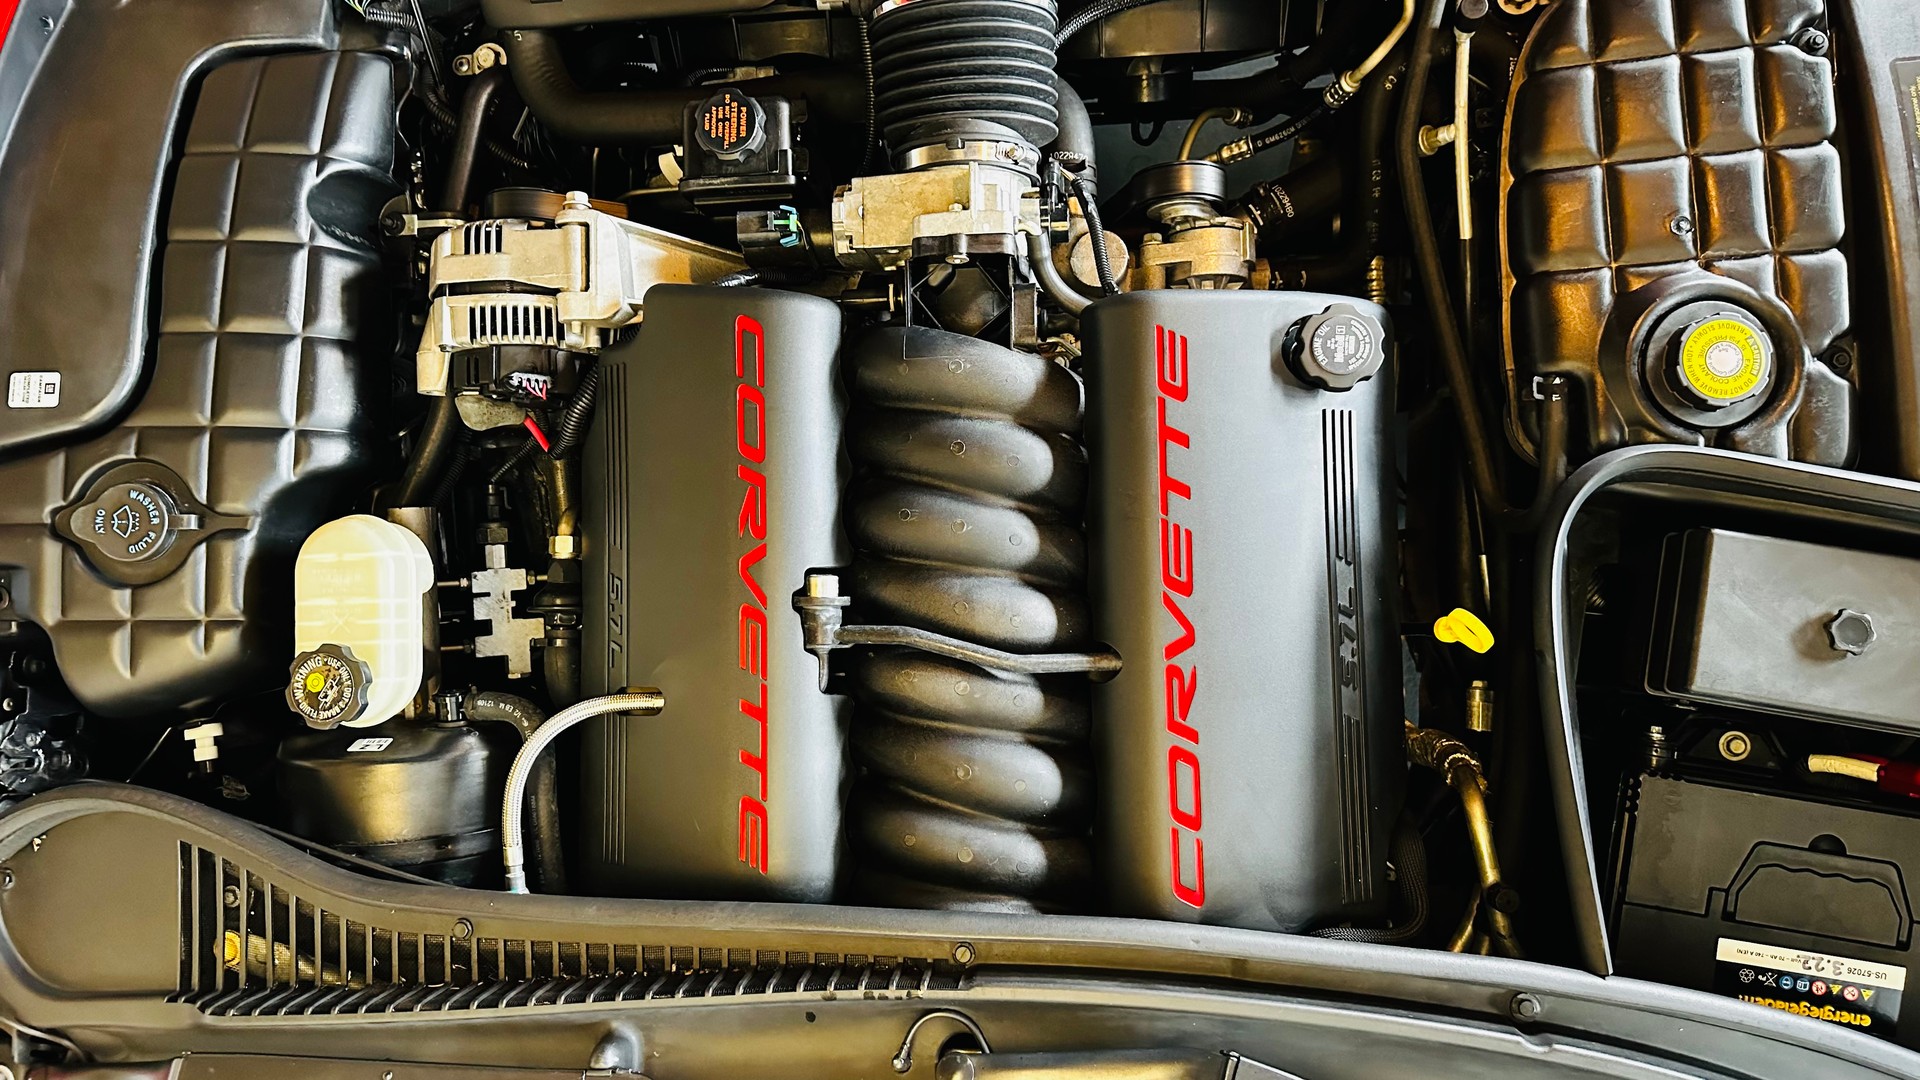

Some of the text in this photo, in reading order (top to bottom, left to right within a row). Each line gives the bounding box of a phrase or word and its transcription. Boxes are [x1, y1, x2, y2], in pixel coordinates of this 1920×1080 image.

[725, 94, 730, 103] DO
[1691, 323, 1745, 342] REMOVE SLOWLY
[1313, 324, 1330, 365] ENGINE OIL
[1698, 335, 1728, 358] PRESSURE
[1746, 335, 1760, 376] CAUTION
[1687, 363, 1700, 383] WHEN
[1699, 358, 1750, 384] ENGINE COOLANT
[1699, 382, 1728, 395] REMOVE
[1730, 384, 1743, 394] NOT
[1744, 378, 1752, 386] DO
[95, 509, 105, 534] ONLY
[128, 489, 160, 554] WASHER FLUID
[735, 314, 768, 874] CORVETTE
[609, 573, 623, 669] 5.7L
[1155, 323, 1205, 908] CORVETTE
[1338, 587, 1358, 691] 5.7L
[327, 658, 340, 669] USE
[293, 656, 322, 700] WARNING
[339, 667, 352, 685] ONLY
[300, 703, 318, 718] FLUID
[319, 706, 341, 719] BRAKE
[1847, 967, 1887, 980] US-57026
